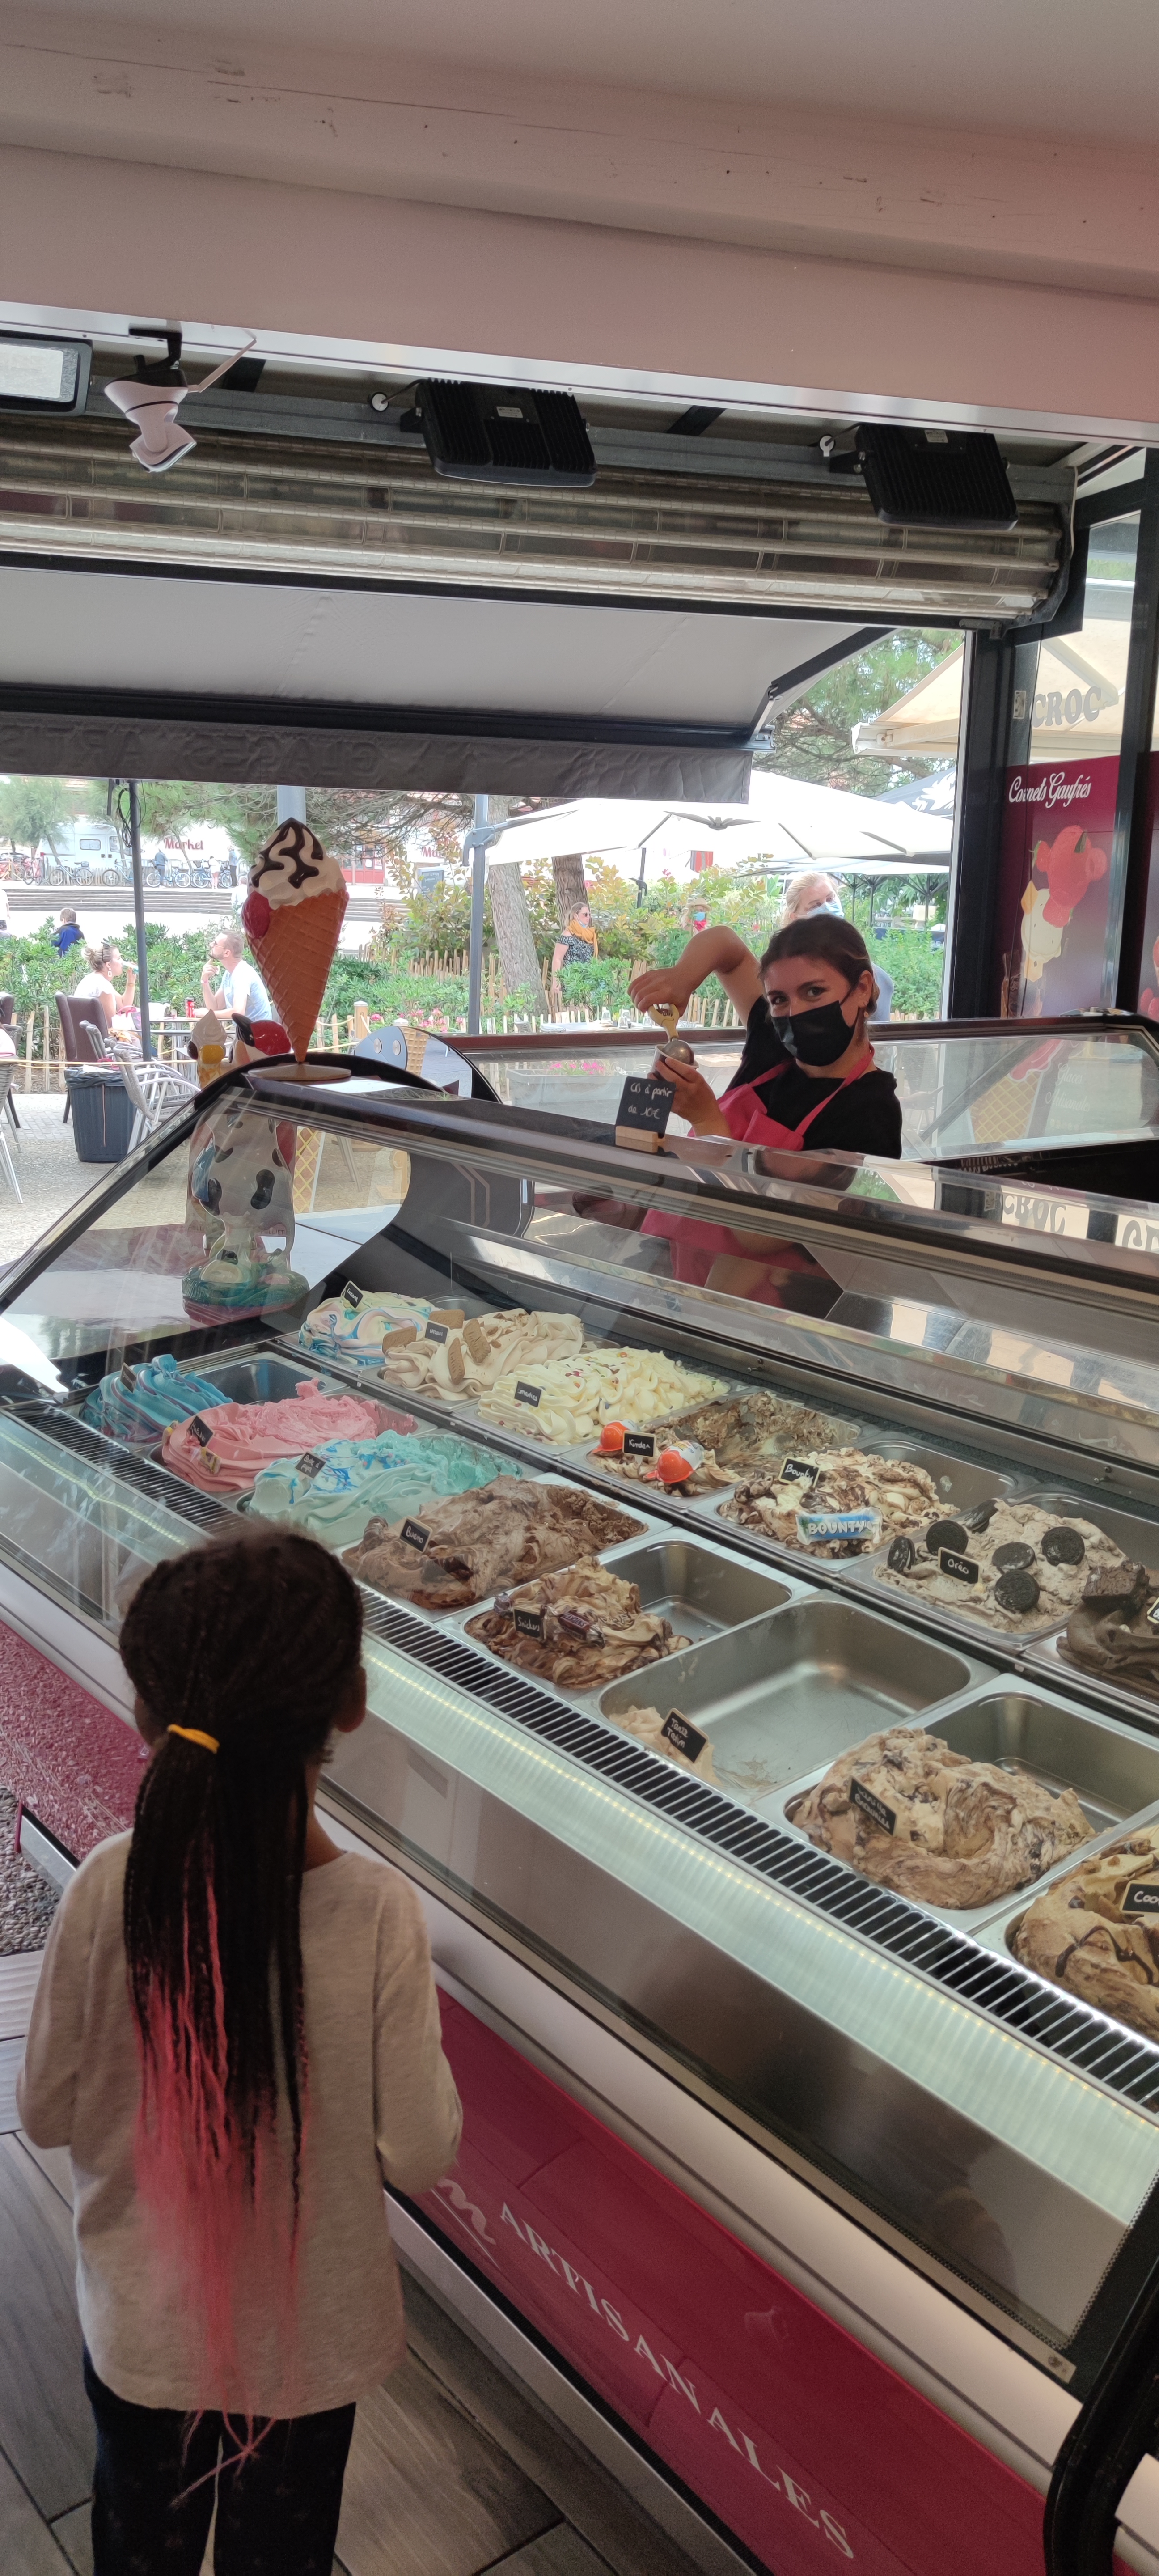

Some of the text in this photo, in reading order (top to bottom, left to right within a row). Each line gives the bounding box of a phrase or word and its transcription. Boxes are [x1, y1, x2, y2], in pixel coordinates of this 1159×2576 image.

[651, 1087, 673, 1100] partir
[628, 1105, 660, 1119] de 10€
[629, 1439, 651, 1449] Kinder
[406, 1526, 423, 1544] Bueno
[808, 1521, 866, 1535] BOUNTY
[518, 1616, 540, 1632] Snickers
[1134, 1890, 1159, 1907] Coo
[500, 2202, 854, 2559] ARTISANALES
